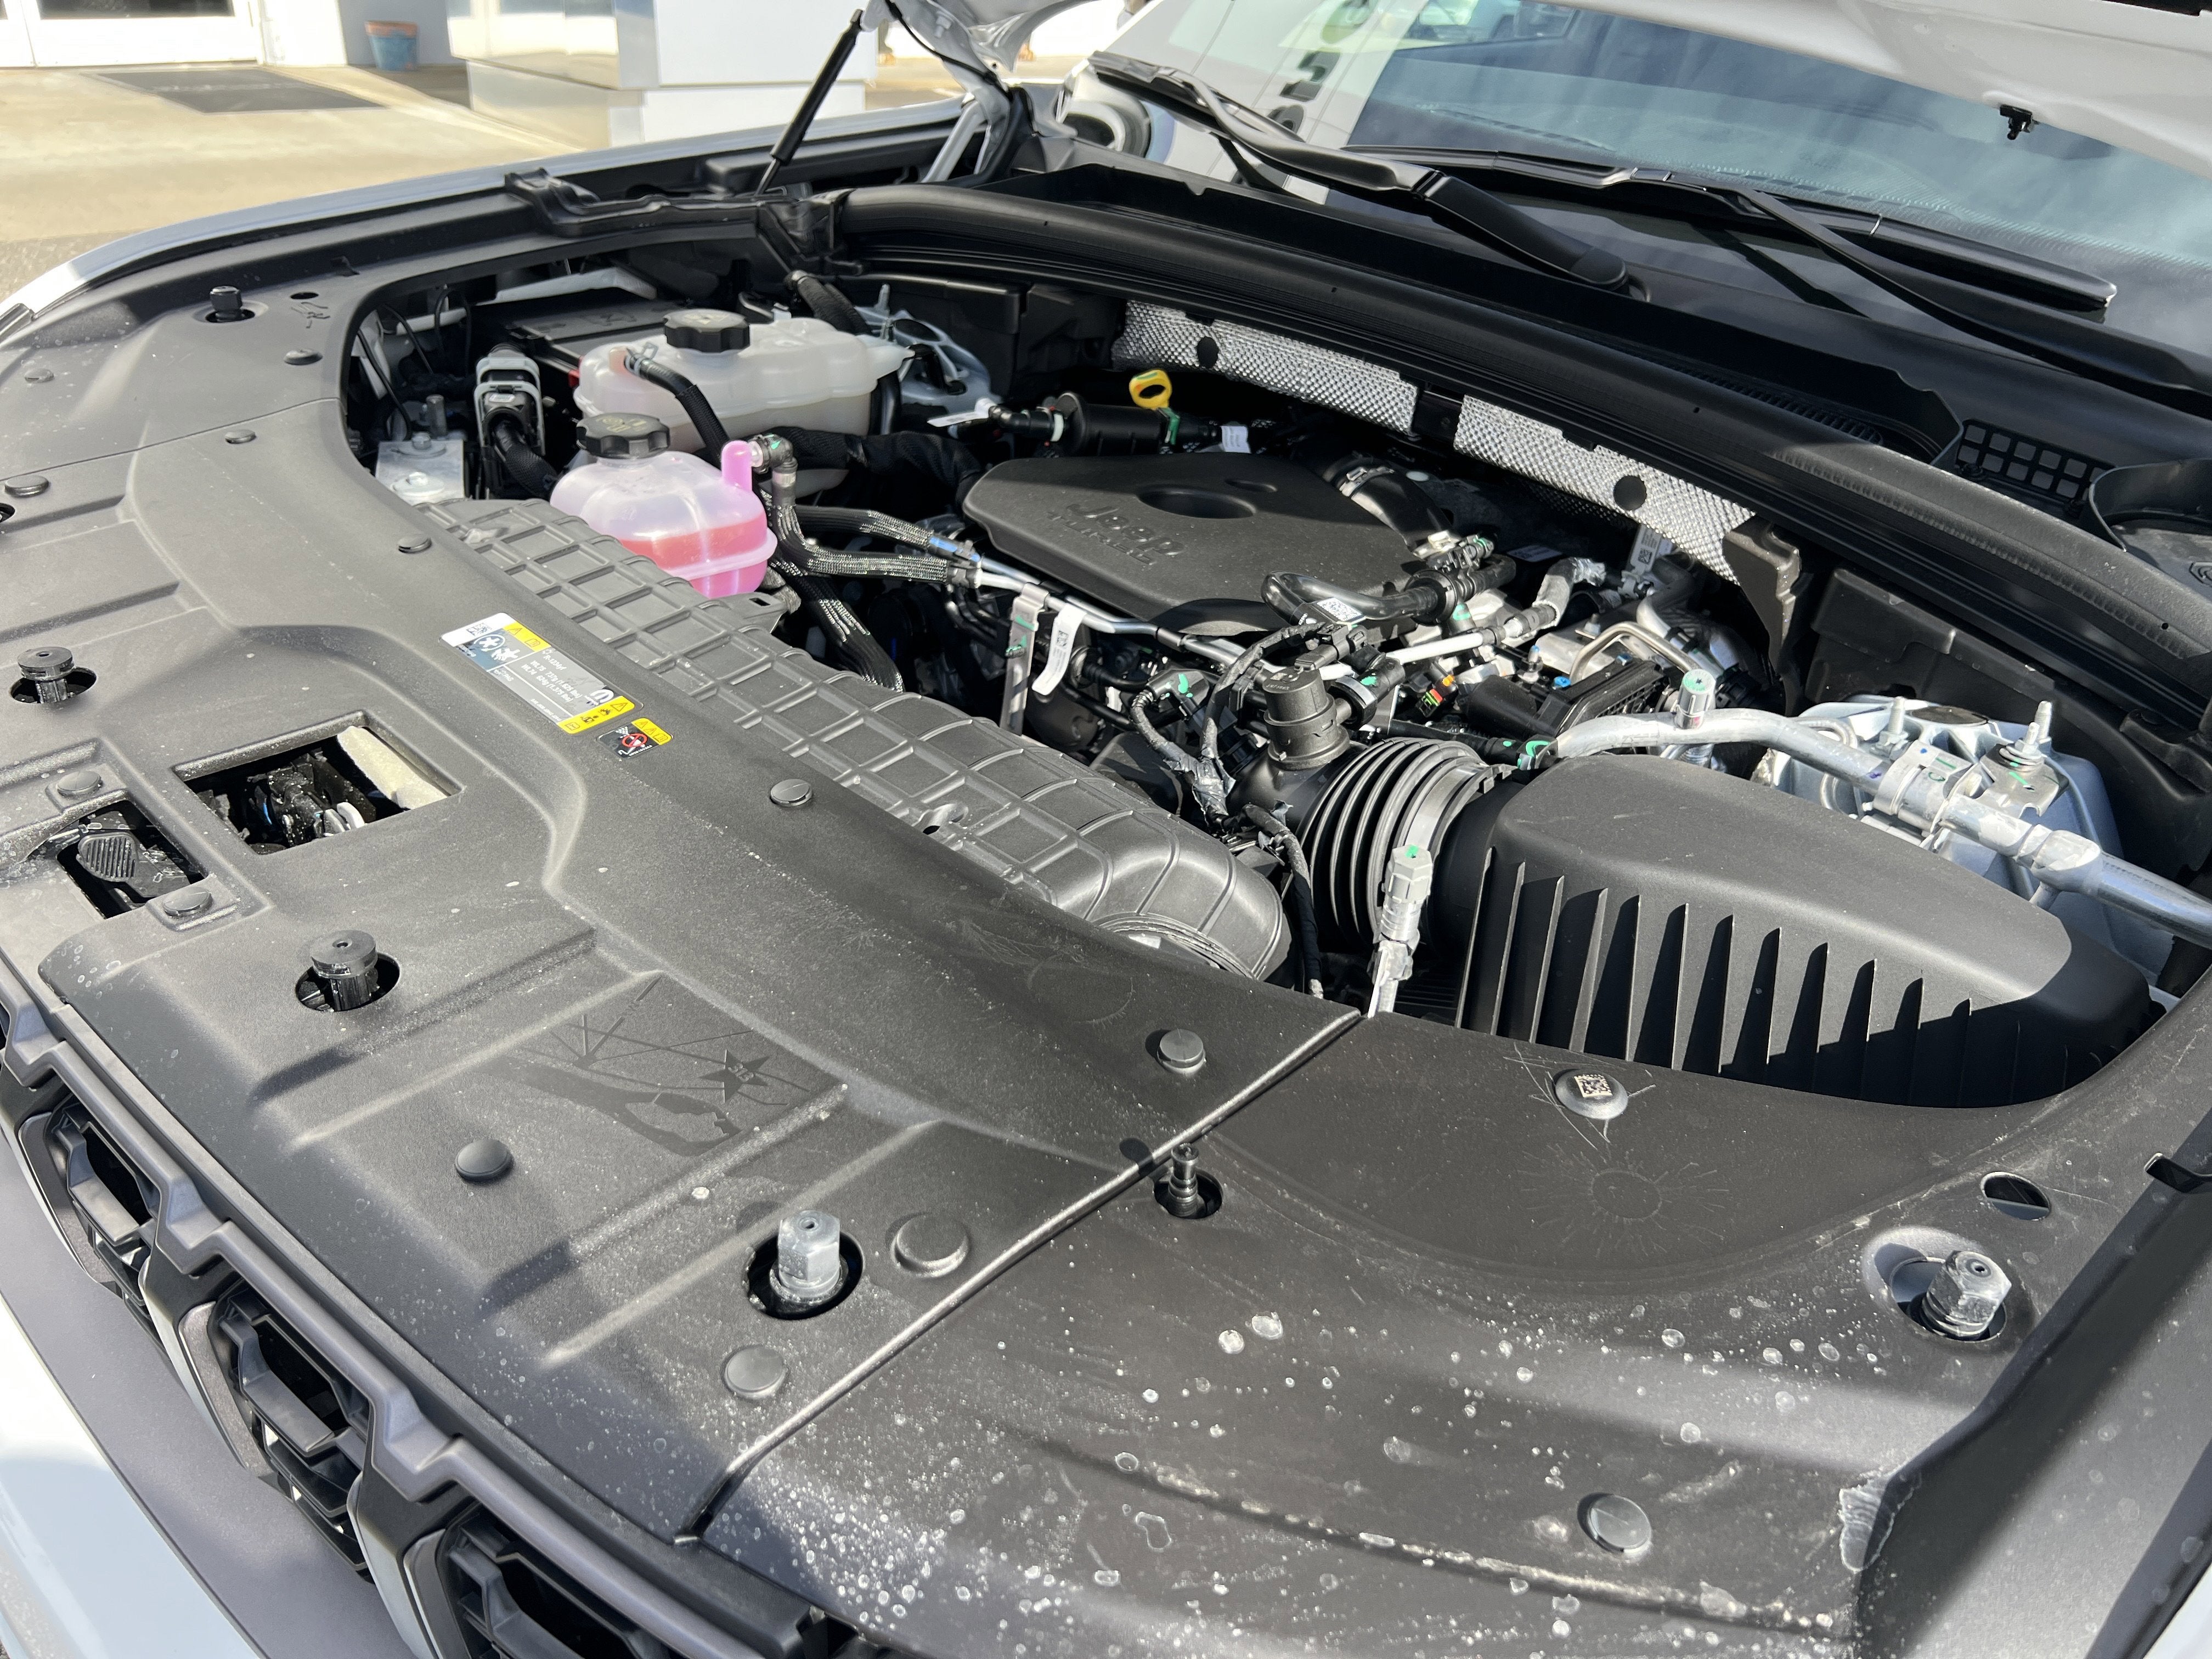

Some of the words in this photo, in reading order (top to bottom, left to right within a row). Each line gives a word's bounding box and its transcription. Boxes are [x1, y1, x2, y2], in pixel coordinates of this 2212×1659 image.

[1066, 503, 1187, 556] Jeep
[543, 654, 567, 670] R-1234yf
[727, 1062, 754, 1082] 313
